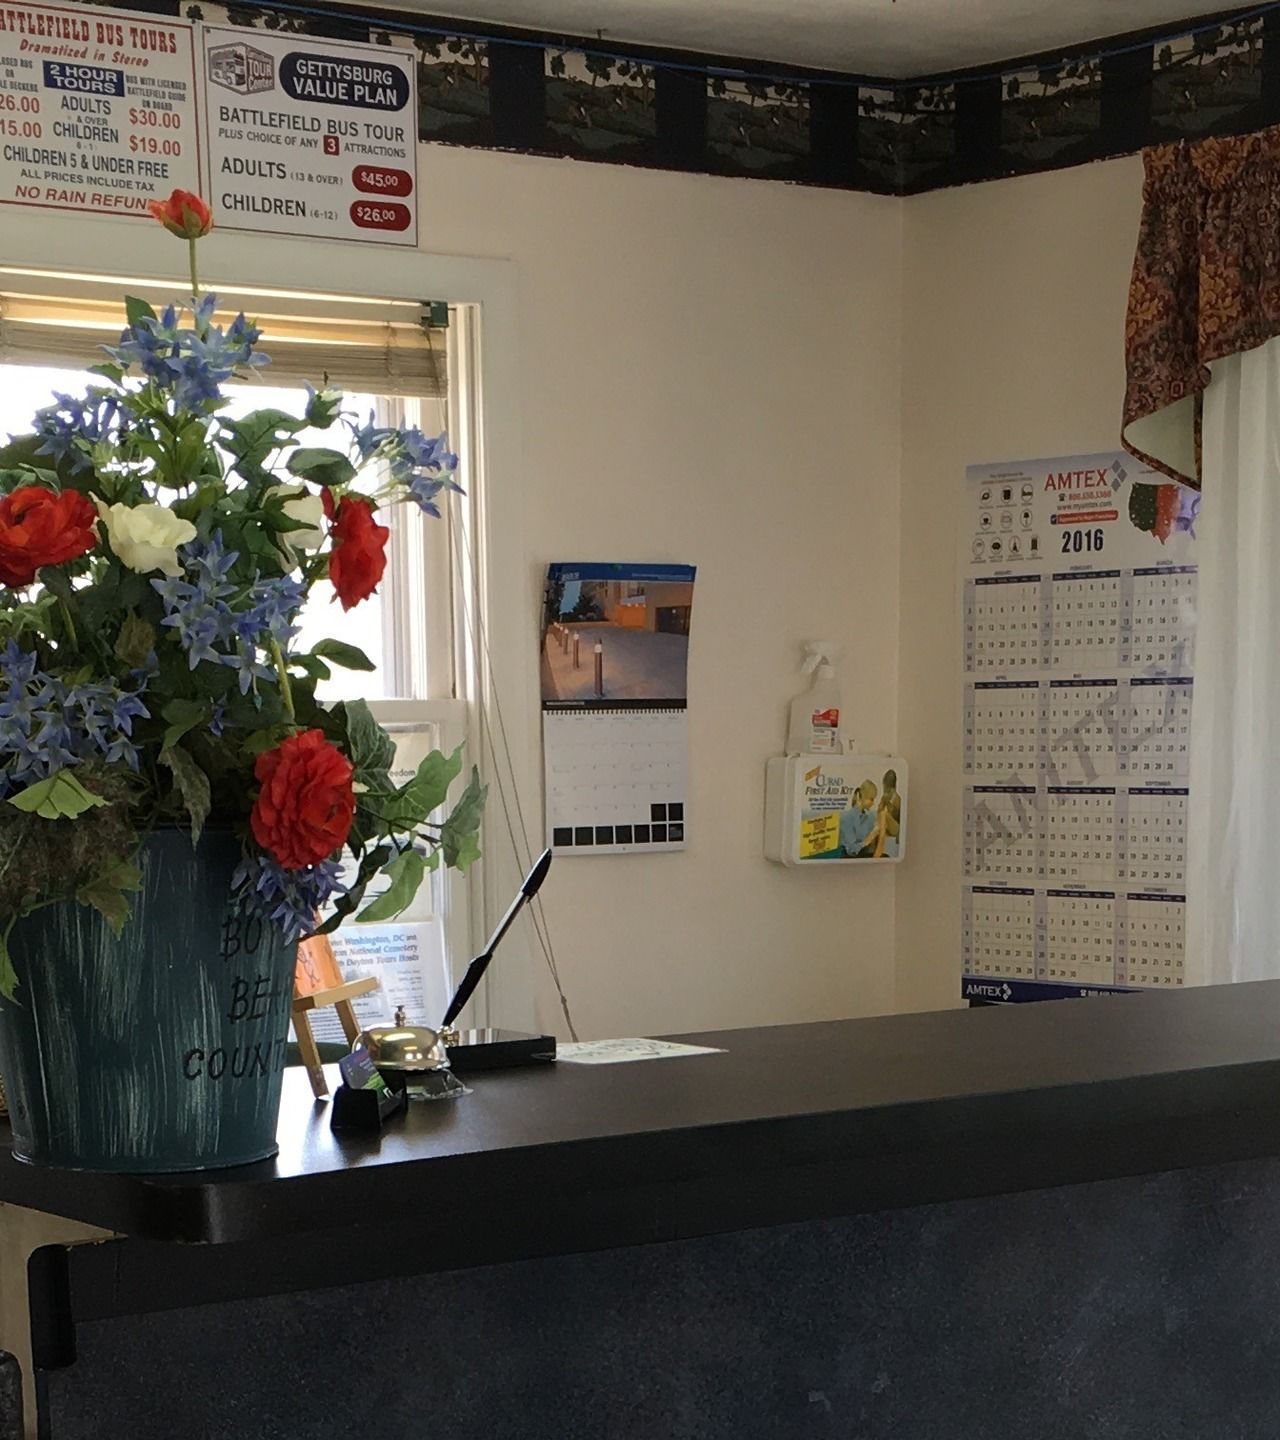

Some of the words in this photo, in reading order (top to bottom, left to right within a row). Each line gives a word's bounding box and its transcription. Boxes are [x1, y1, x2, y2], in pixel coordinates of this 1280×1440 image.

[96, 23, 124, 47] BUS
[130, 27, 177, 53] TOURS
[20, 39, 87, 60] Dramatized
[93, 50, 105, 61] in
[112, 51, 149, 67] Stereo
[50, 65, 60, 76] 2
[65, 66, 117, 82] HOUR
[53, 76, 116, 94] TOURS
[296, 59, 393, 86] GETTYSBURG
[293, 76, 349, 100] VALUE
[354, 84, 398, 106] PLAN
[61, 95, 112, 115] ADULTS
[129, 108, 181, 129] $30.00
[219, 105, 321, 133] BATTLEFIELD
[327, 119, 359, 137] BUS
[363, 122, 405, 142] TOUR
[53, 122, 118, 143] CHILDREN
[129, 135, 181, 156] $19.00
[218, 128, 243, 140] PLUS
[247, 131, 281, 145] CHOICE
[284, 135, 297, 146] OF
[299, 137, 318, 149] ANY
[326, 136, 336, 152] 3
[343, 142, 406, 158] ATTRACTIONS
[3, 145, 68, 167] CHILDREN
[70, 154, 78, 168] 5
[80, 155, 89, 169] &
[92, 156, 134, 175] UNDER
[137, 160, 169, 179] FREE
[221, 156, 287, 179] ADULTS
[360, 171, 399, 188] $45.00
[15, 185, 41, 199] NO
[45, 188, 86, 204] RAIN
[20, 168, 41, 180] ALL
[44, 171, 84, 184] PRICES
[86, 175, 133, 190] INCLUDE
[136, 180, 155, 192] TAX
[221, 193, 306, 217] CHILDREN
[356, 206, 396, 223] $26.00
[1044, 468, 1108, 491] AMTEX
[1061, 528, 1104, 553] 2016
[966, 983, 1001, 998] AMTEX
